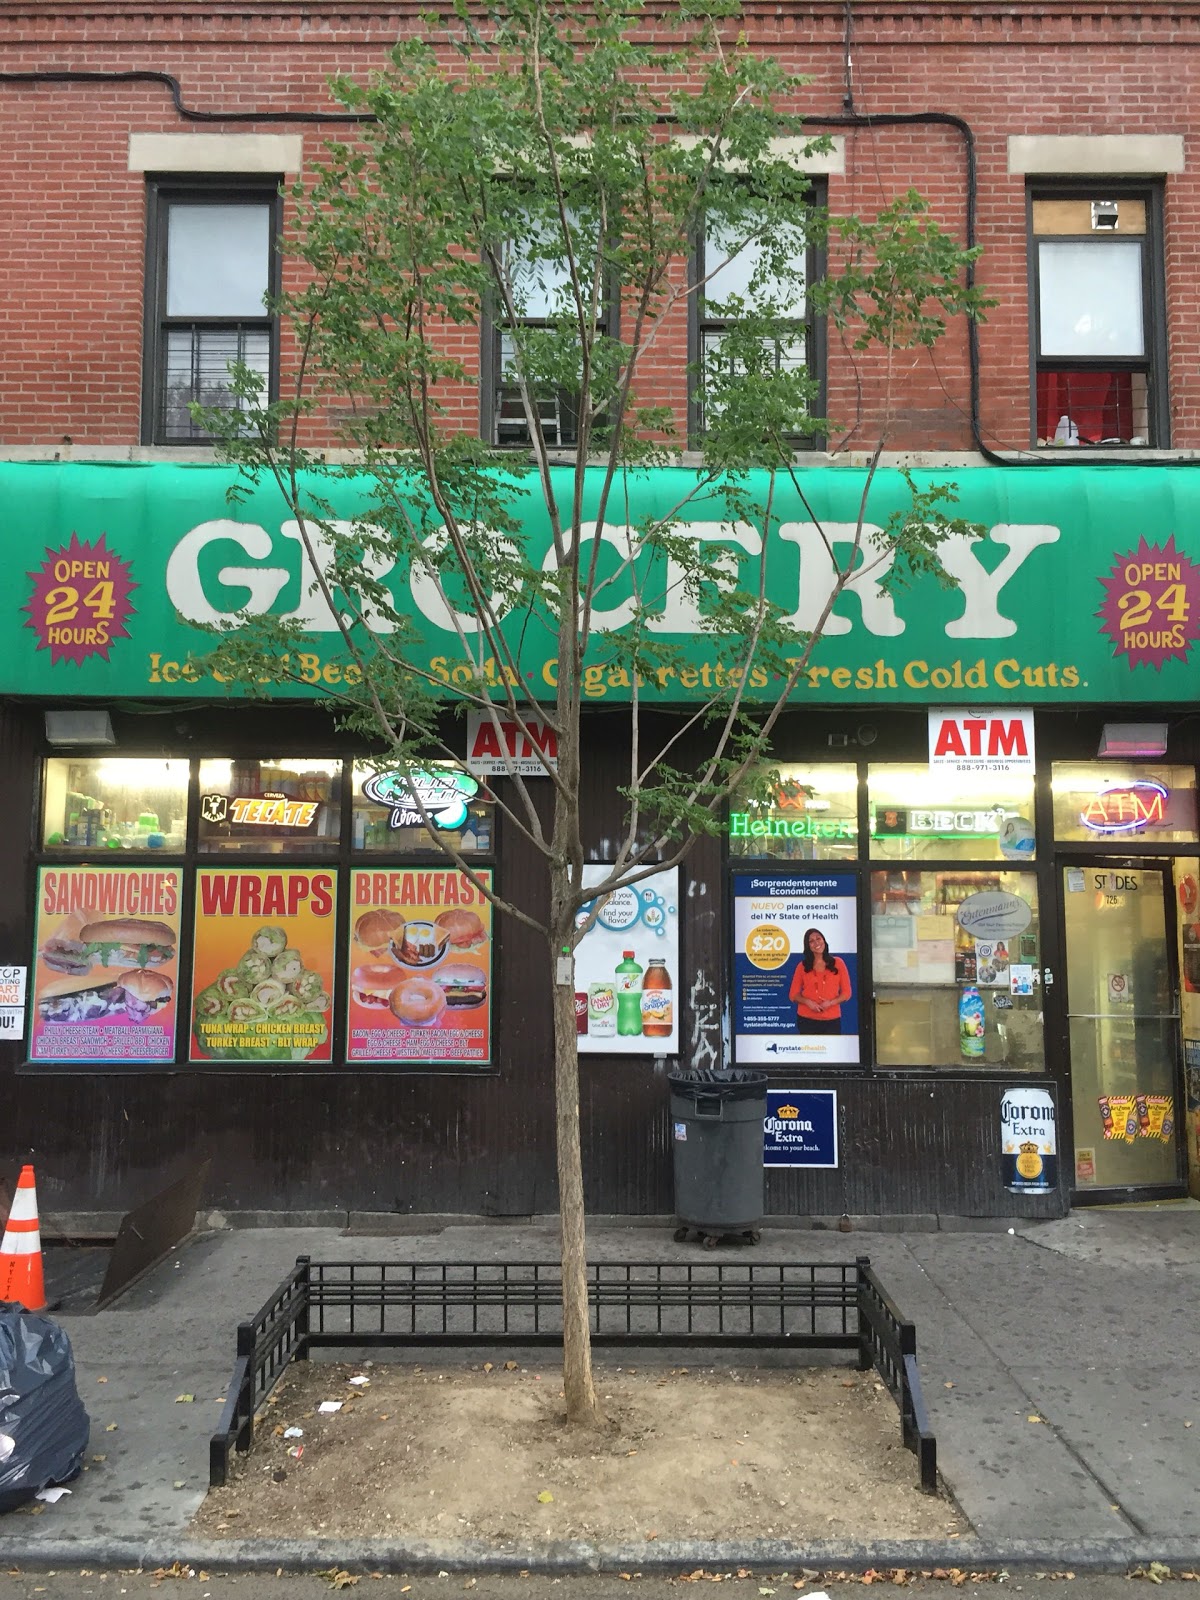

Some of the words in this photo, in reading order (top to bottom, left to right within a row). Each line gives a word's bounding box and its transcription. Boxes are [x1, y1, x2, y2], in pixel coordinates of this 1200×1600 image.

[55, 560, 110, 583] OPEN
[166, 519, 1061, 640] GROCERY
[1125, 563, 1181, 586] OPEN
[45, 581, 116, 625] 24
[1118, 584, 1190, 630] 24
[48, 621, 109, 645] HOURS
[1124, 624, 1186, 648] HOURS
[149, 653, 199, 683] Ice
[298, 654, 375, 685] Bee
[785, 657, 898, 689] Fresh
[902, 658, 988, 689] Cold
[994, 658, 1088, 689] Cuts.
[471, 722, 560, 757] ATM
[934, 720, 1028, 756] ATM
[230, 798, 319, 827] TECATE
[1085, 792, 1163, 820] ATM
[731, 812, 854, 838] Heineken
[44, 872, 178, 914] SANDWICHES
[355, 873, 490, 905] BREAKFAST
[751, 879, 838, 888] ¡Sorprendentemente
[770, 888, 819, 896] Económico!
[1116, 876, 1138, 890] DES
[201, 874, 333, 917] WRAPS
[751, 902, 784, 911] NUEVO
[786, 903, 804, 912] plan
[752, 935, 786, 952] $20
[0, 968, 20, 978] OP
[644, 998, 670, 1011] Snapple
[200, 1024, 223, 1034] TUNA
[224, 1024, 249, 1034] WRAP
[255, 1024, 292, 1034] CHICKEN
[293, 1024, 325, 1034] BREAST
[206, 1037, 238, 1047] TURKEY
[239, 1037, 270, 1047] BREAST
[277, 1037, 292, 1047] BLT
[293, 1037, 318, 1047] WRAP
[764, 1116, 813, 1135] Corona
[775, 1131, 803, 1142] Extra
[1013, 1122, 1045, 1136] Extra
